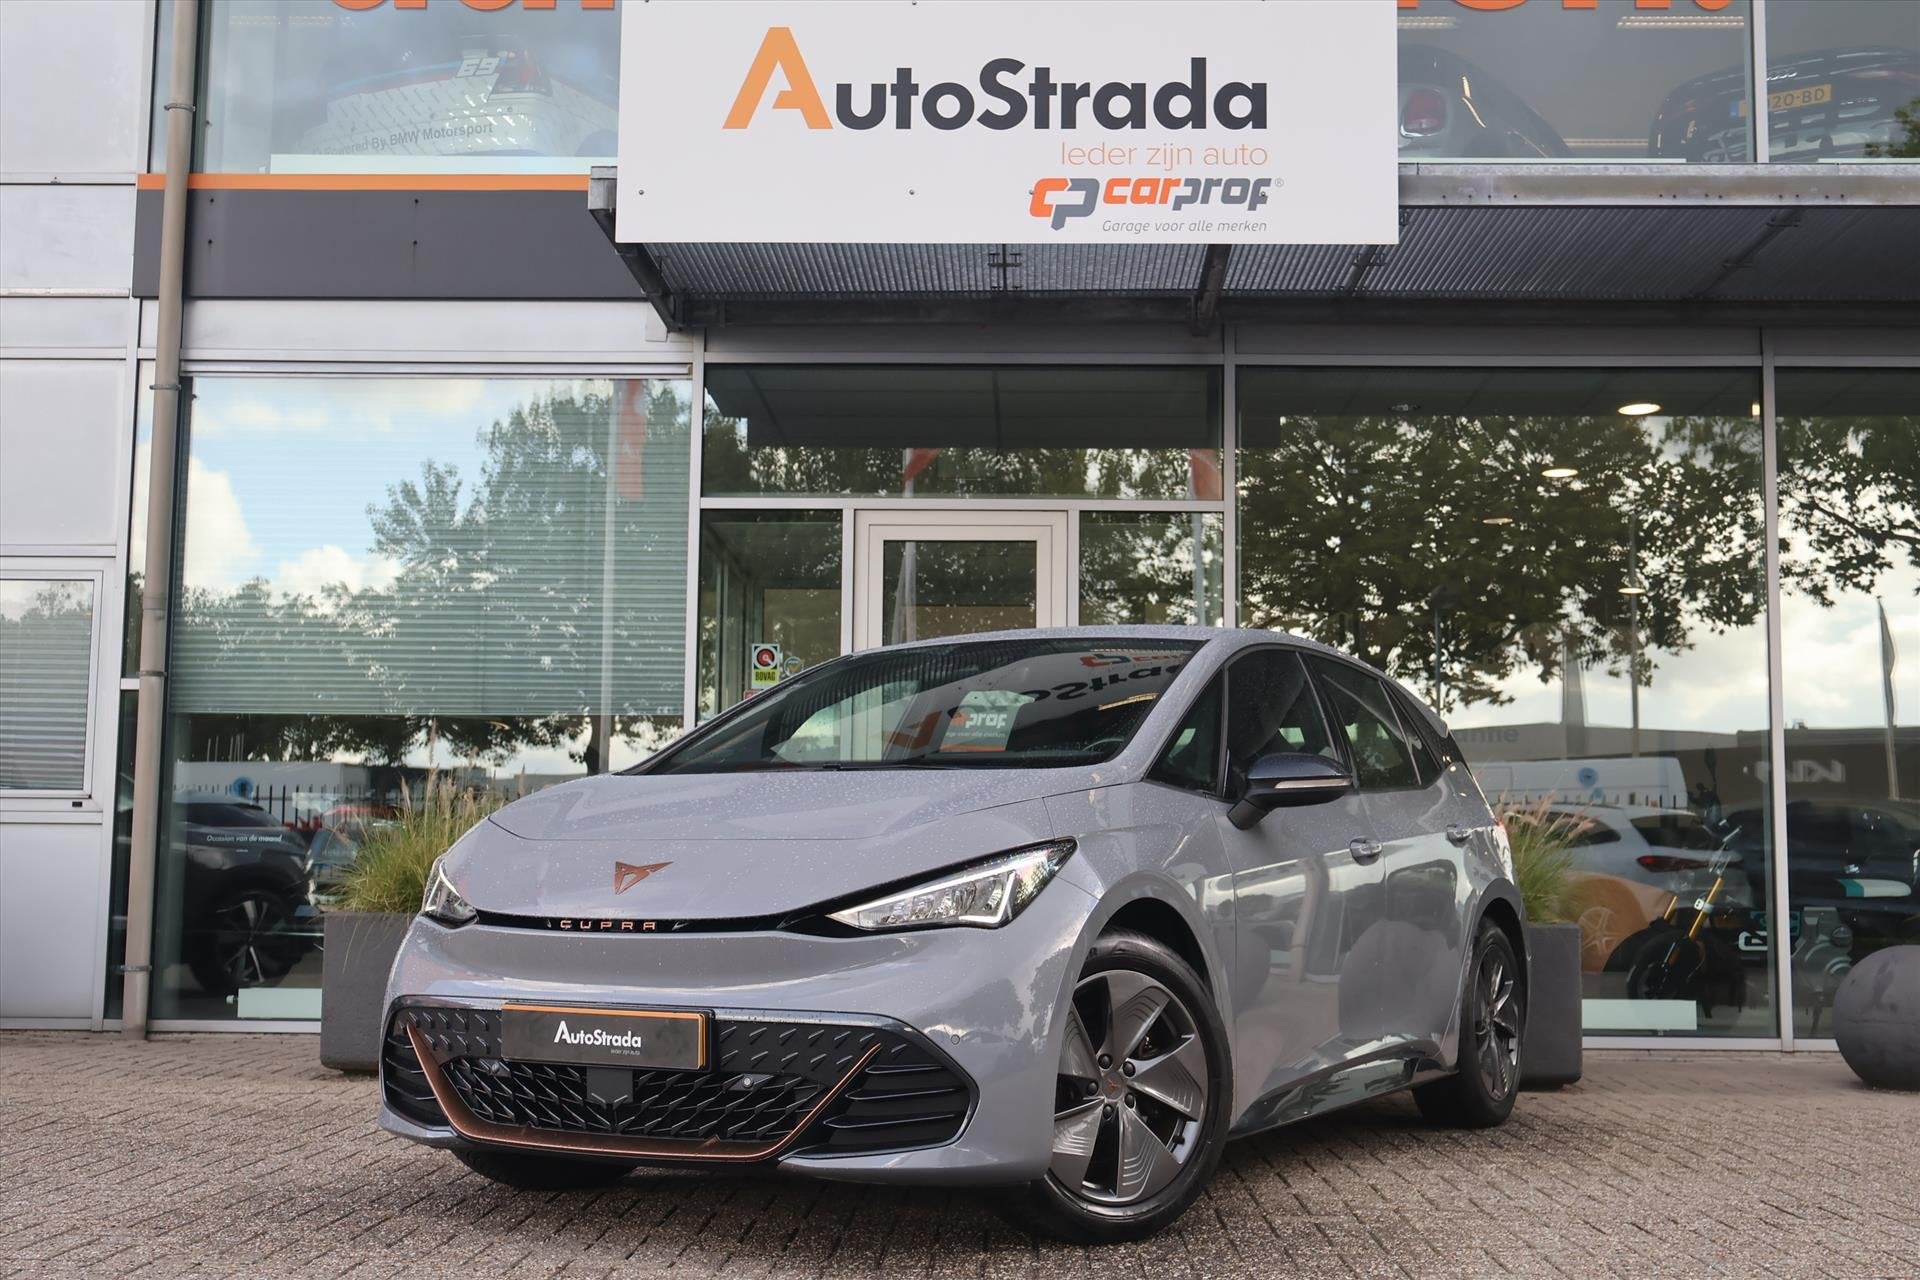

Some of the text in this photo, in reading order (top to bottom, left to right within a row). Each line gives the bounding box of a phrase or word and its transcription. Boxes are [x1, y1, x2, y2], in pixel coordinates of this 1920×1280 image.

[723, 27, 1268, 131] AutoStrada
[371, 137, 386, 150] By
[389, 128, 421, 146] BMW
[423, 122, 494, 140] Motorsport
[1061, 142, 1268, 171] Ieder zijn auto
[1103, 178, 1272, 211] carprof
[1102, 220, 1267, 234] Garage voor alle merken
[755, 671, 776, 681] BOVAG
[560, 919, 656, 931] CUPRA
[553, 1020, 642, 1048] AutoStrada
